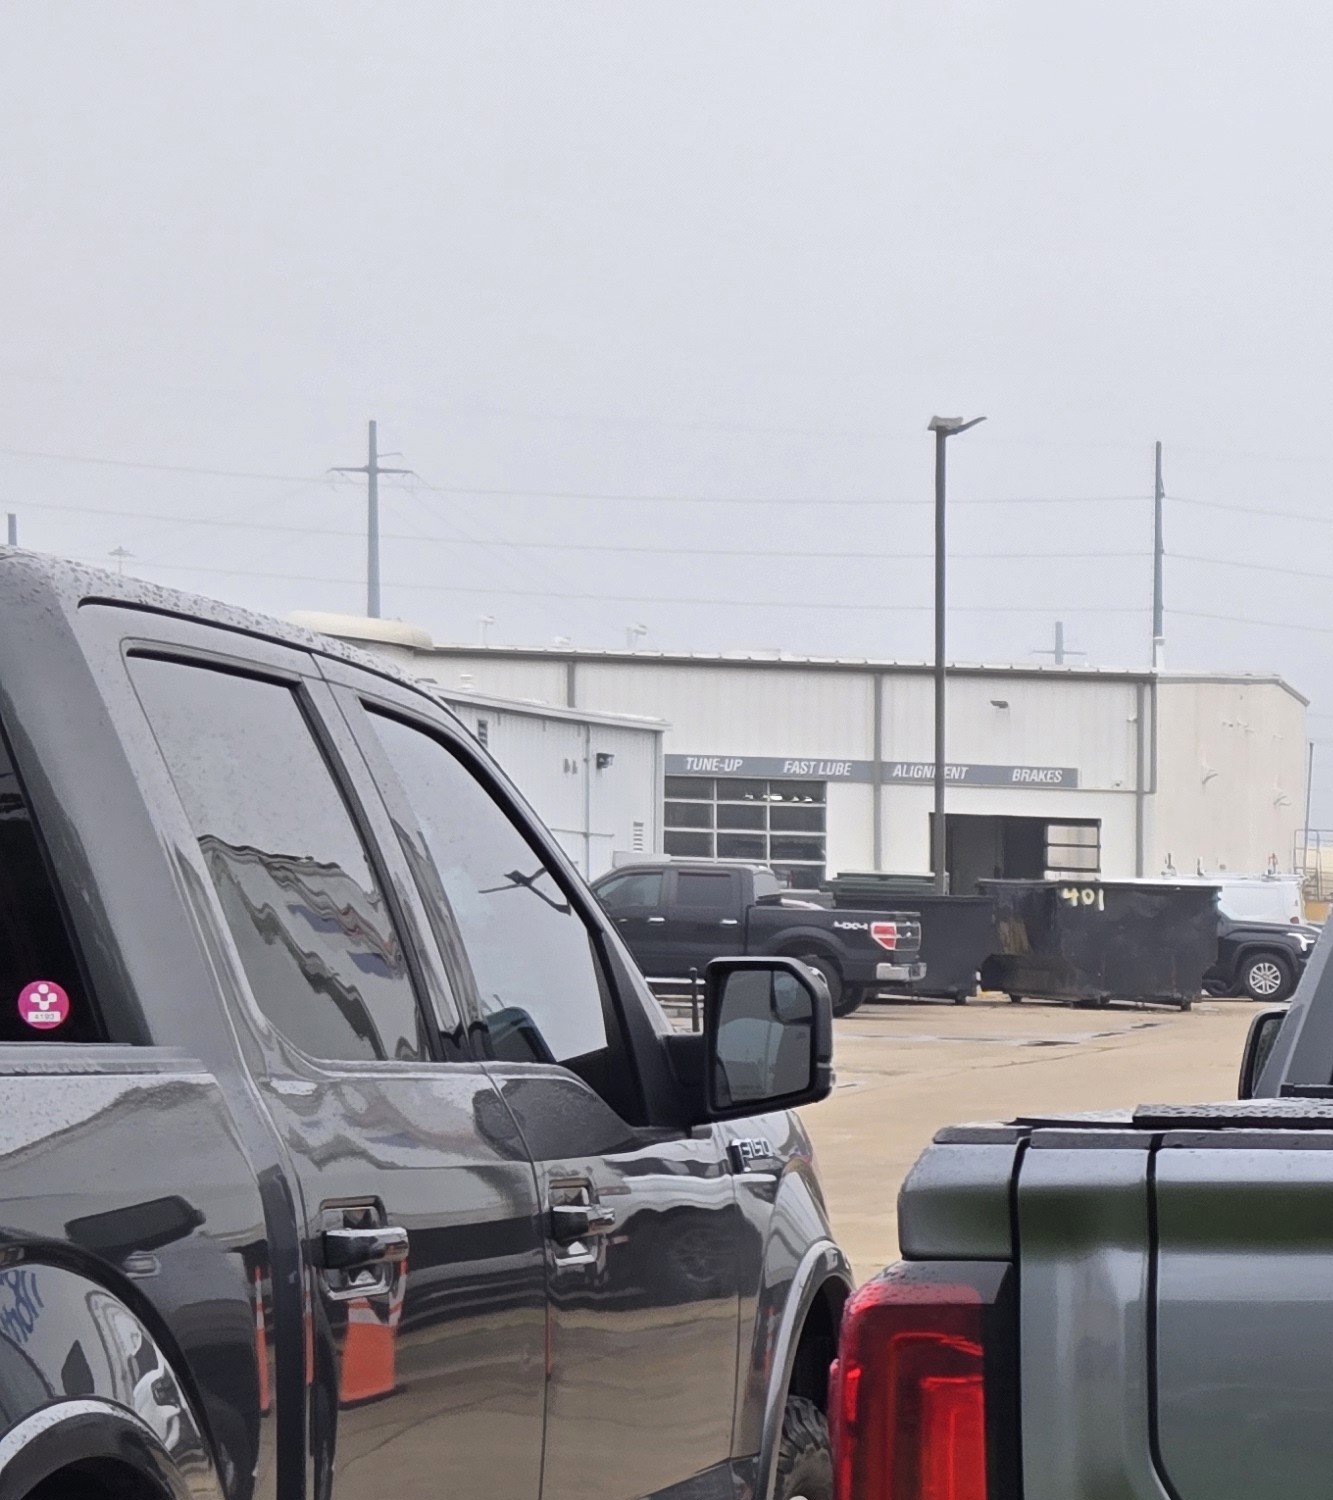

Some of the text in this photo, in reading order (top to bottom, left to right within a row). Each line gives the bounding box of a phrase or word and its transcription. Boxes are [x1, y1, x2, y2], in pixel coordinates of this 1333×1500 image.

[686, 757, 1062, 783] TUNE-UP FAST LUBE ALIGNENT BRAKES
[1062, 888, 1105, 911] 401
